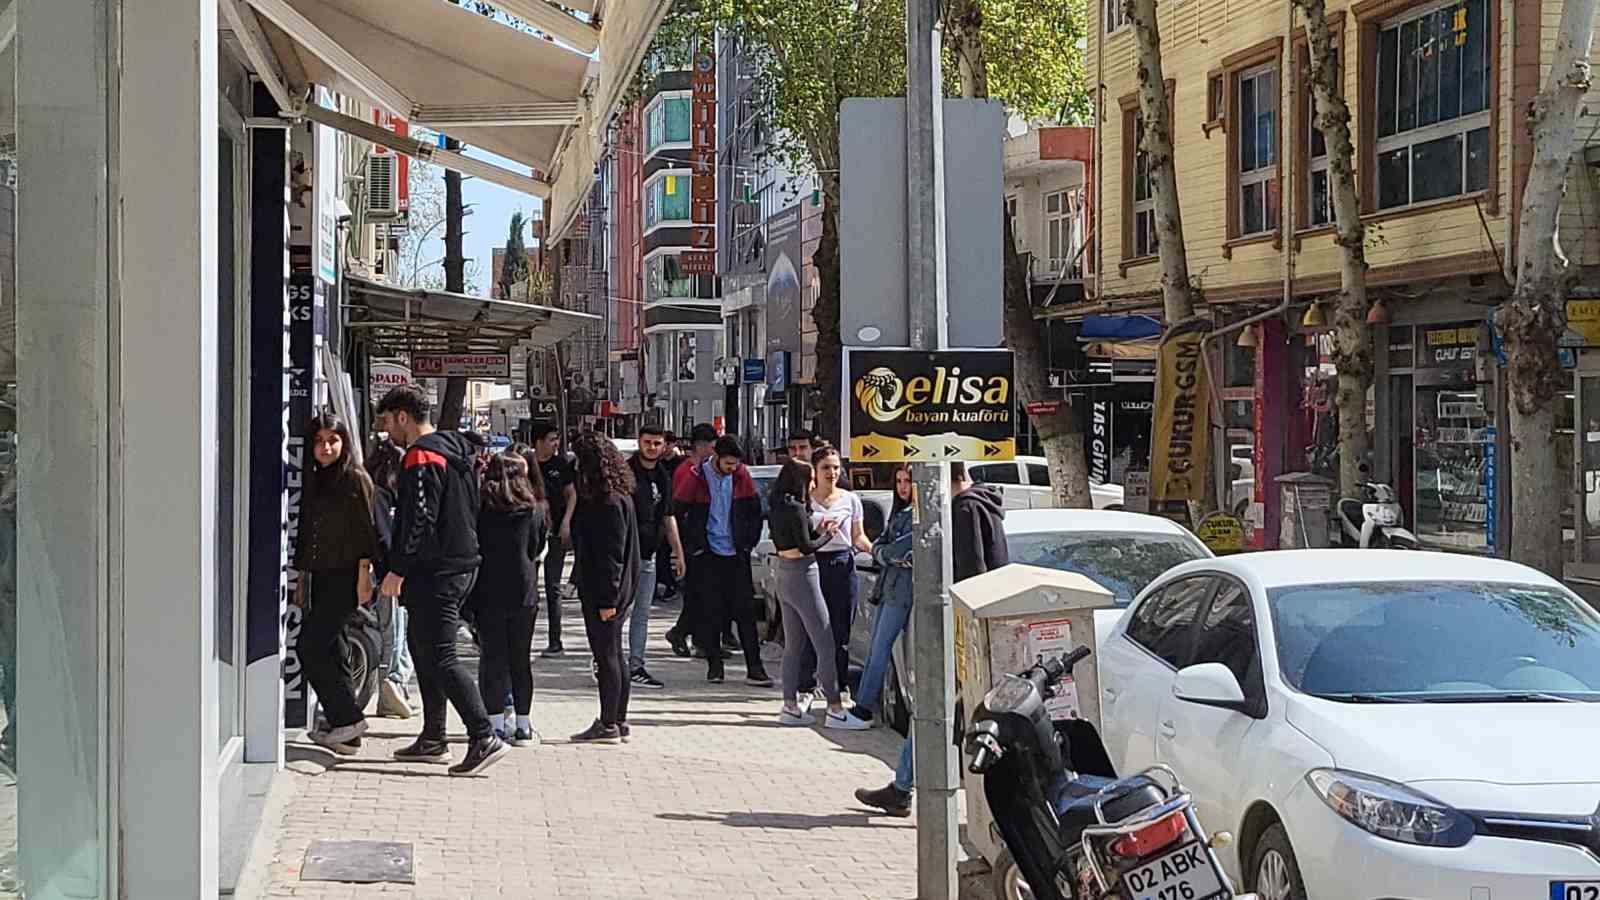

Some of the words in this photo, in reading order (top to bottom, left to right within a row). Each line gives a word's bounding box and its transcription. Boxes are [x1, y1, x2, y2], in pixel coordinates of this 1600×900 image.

[694, 83, 714, 92] VIP
[905, 366, 1009, 405] elisa
[905, 409, 948, 425] bayan
[952, 409, 1009, 423] kuaförü
[1129, 867, 1159, 893] 02
[1160, 844, 1205, 881] ABK
